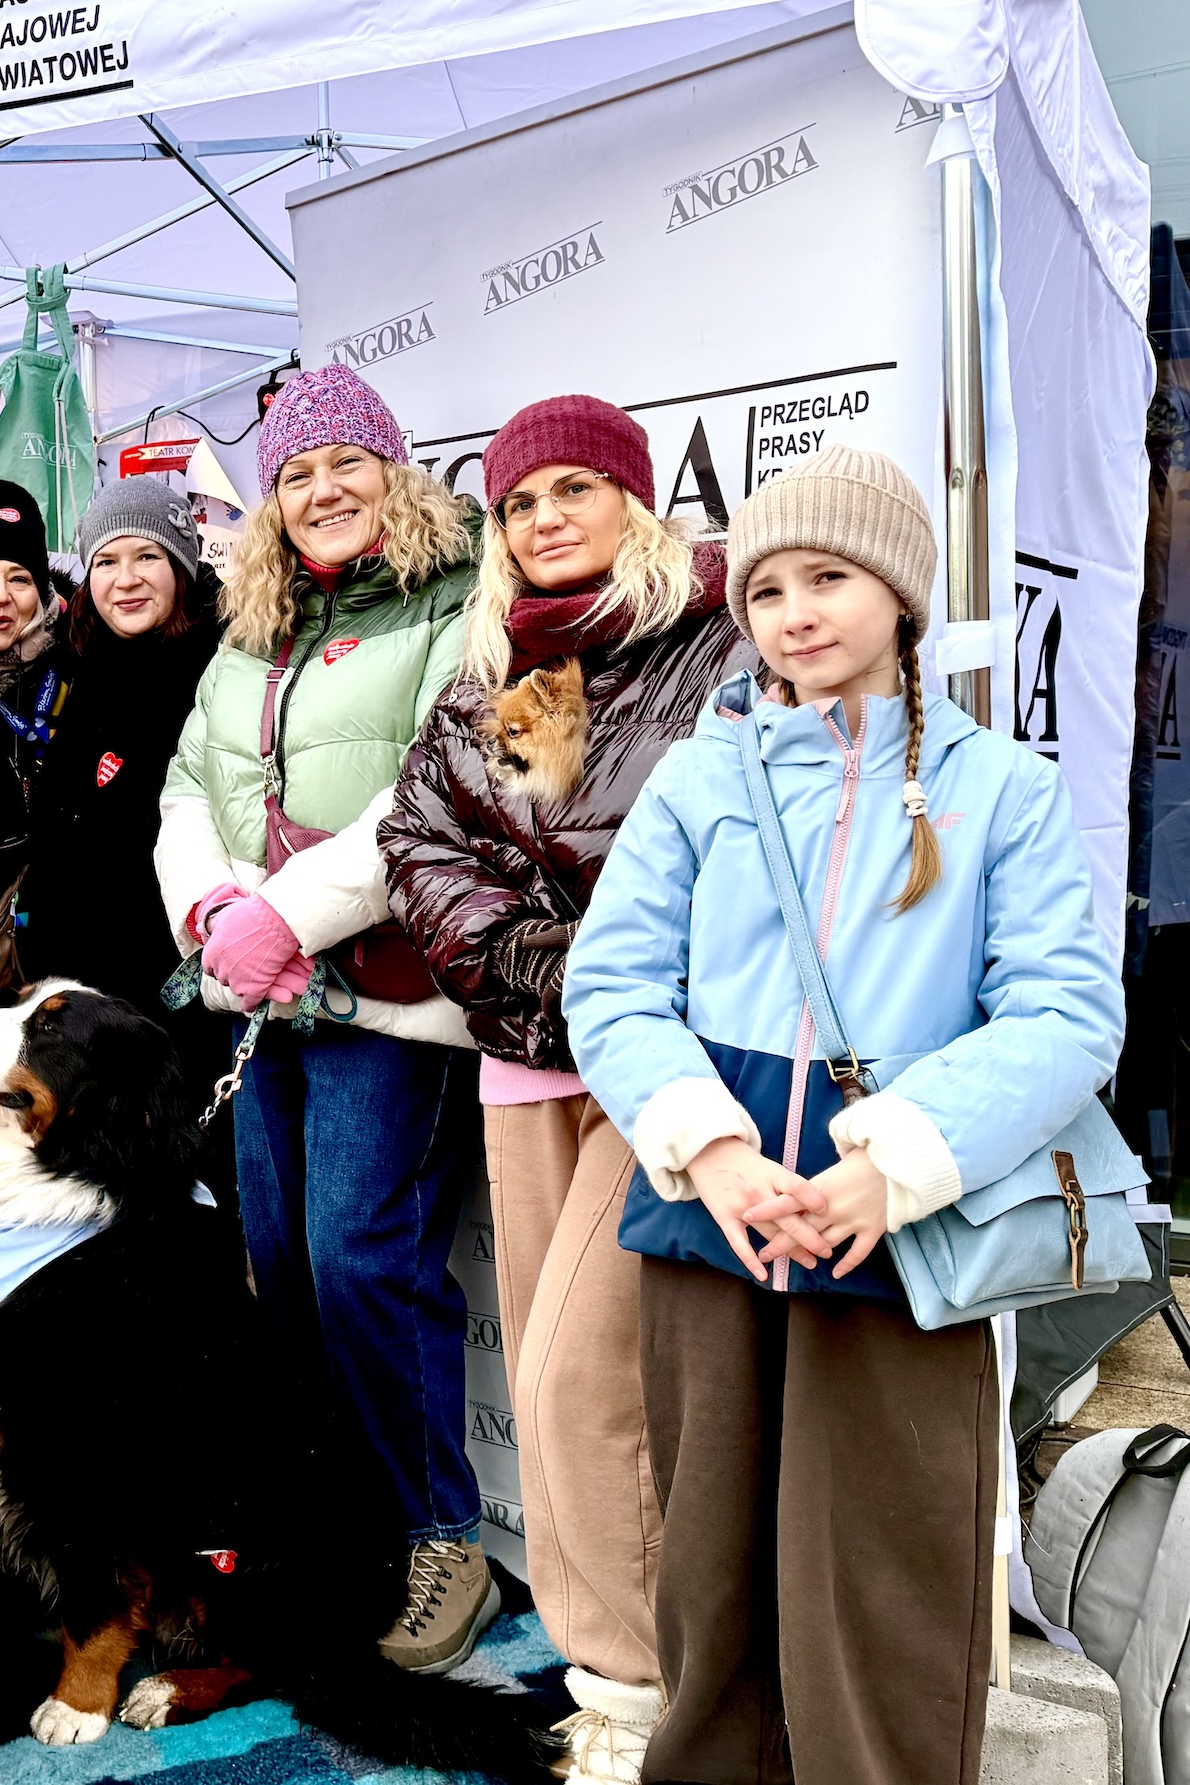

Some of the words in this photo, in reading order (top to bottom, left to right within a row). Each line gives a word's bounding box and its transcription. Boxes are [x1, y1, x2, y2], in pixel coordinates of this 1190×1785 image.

[664, 173, 702, 196] TYGODNIK
[666, 135, 818, 230] ANGORA
[484, 232, 605, 311] ANGORA
[760, 390, 870, 428] PRZEGLĄD
[149, 447, 174, 457] TEATR
[758, 429, 825, 460] PRASY
